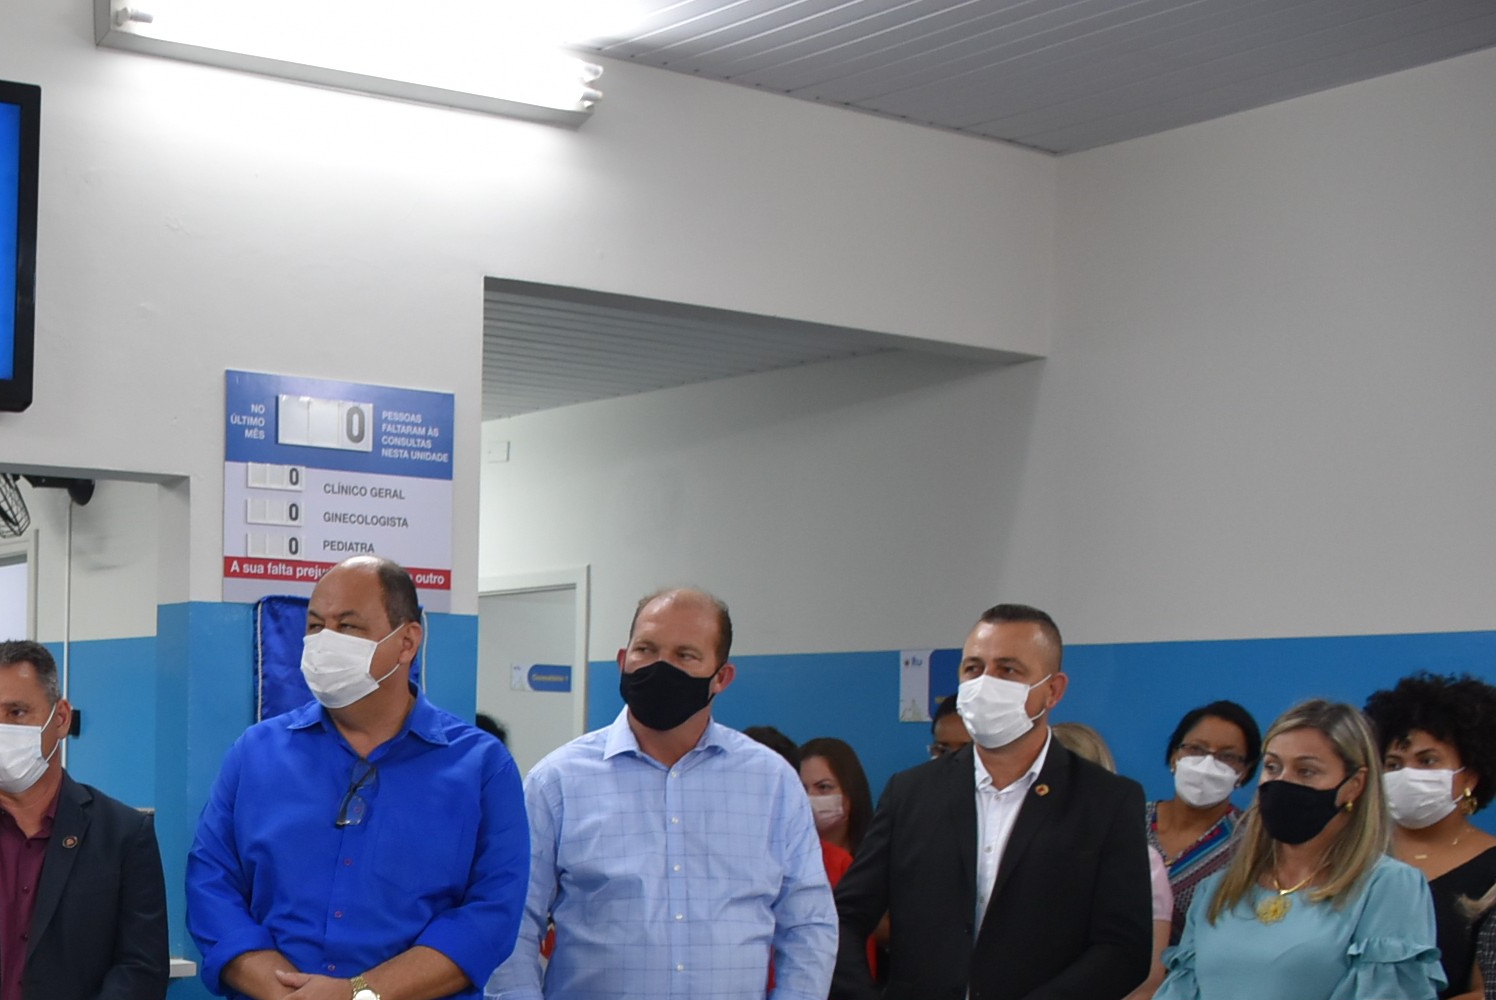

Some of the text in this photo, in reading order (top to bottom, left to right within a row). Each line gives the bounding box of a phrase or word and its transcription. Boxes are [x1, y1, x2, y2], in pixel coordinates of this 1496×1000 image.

[250, 403, 266, 415] NO
[381, 410, 422, 424] PESSOAS
[230, 413, 266, 427] ÚLTIMO
[345, 405, 366, 444] 0
[244, 426, 266, 440] MÊS
[381, 423, 426, 437] FALTARAM
[381, 435, 432, 449] CONSULTAS
[381, 447, 449, 463] NESTA UNIDADE
[288, 467, 300, 486] 0
[323, 482, 406, 501] CLÍNICO GERAL
[288, 503, 300, 522] 0
[323, 511, 409, 529] GINECOLOGISTA
[288, 537, 299, 555] 0
[322, 540, 375, 554] PEDIATRA
[230, 560, 240, 573] A
[242, 562, 265, 575] sua
[267, 560, 294, 576] falta
[415, 571, 445, 586] outro
